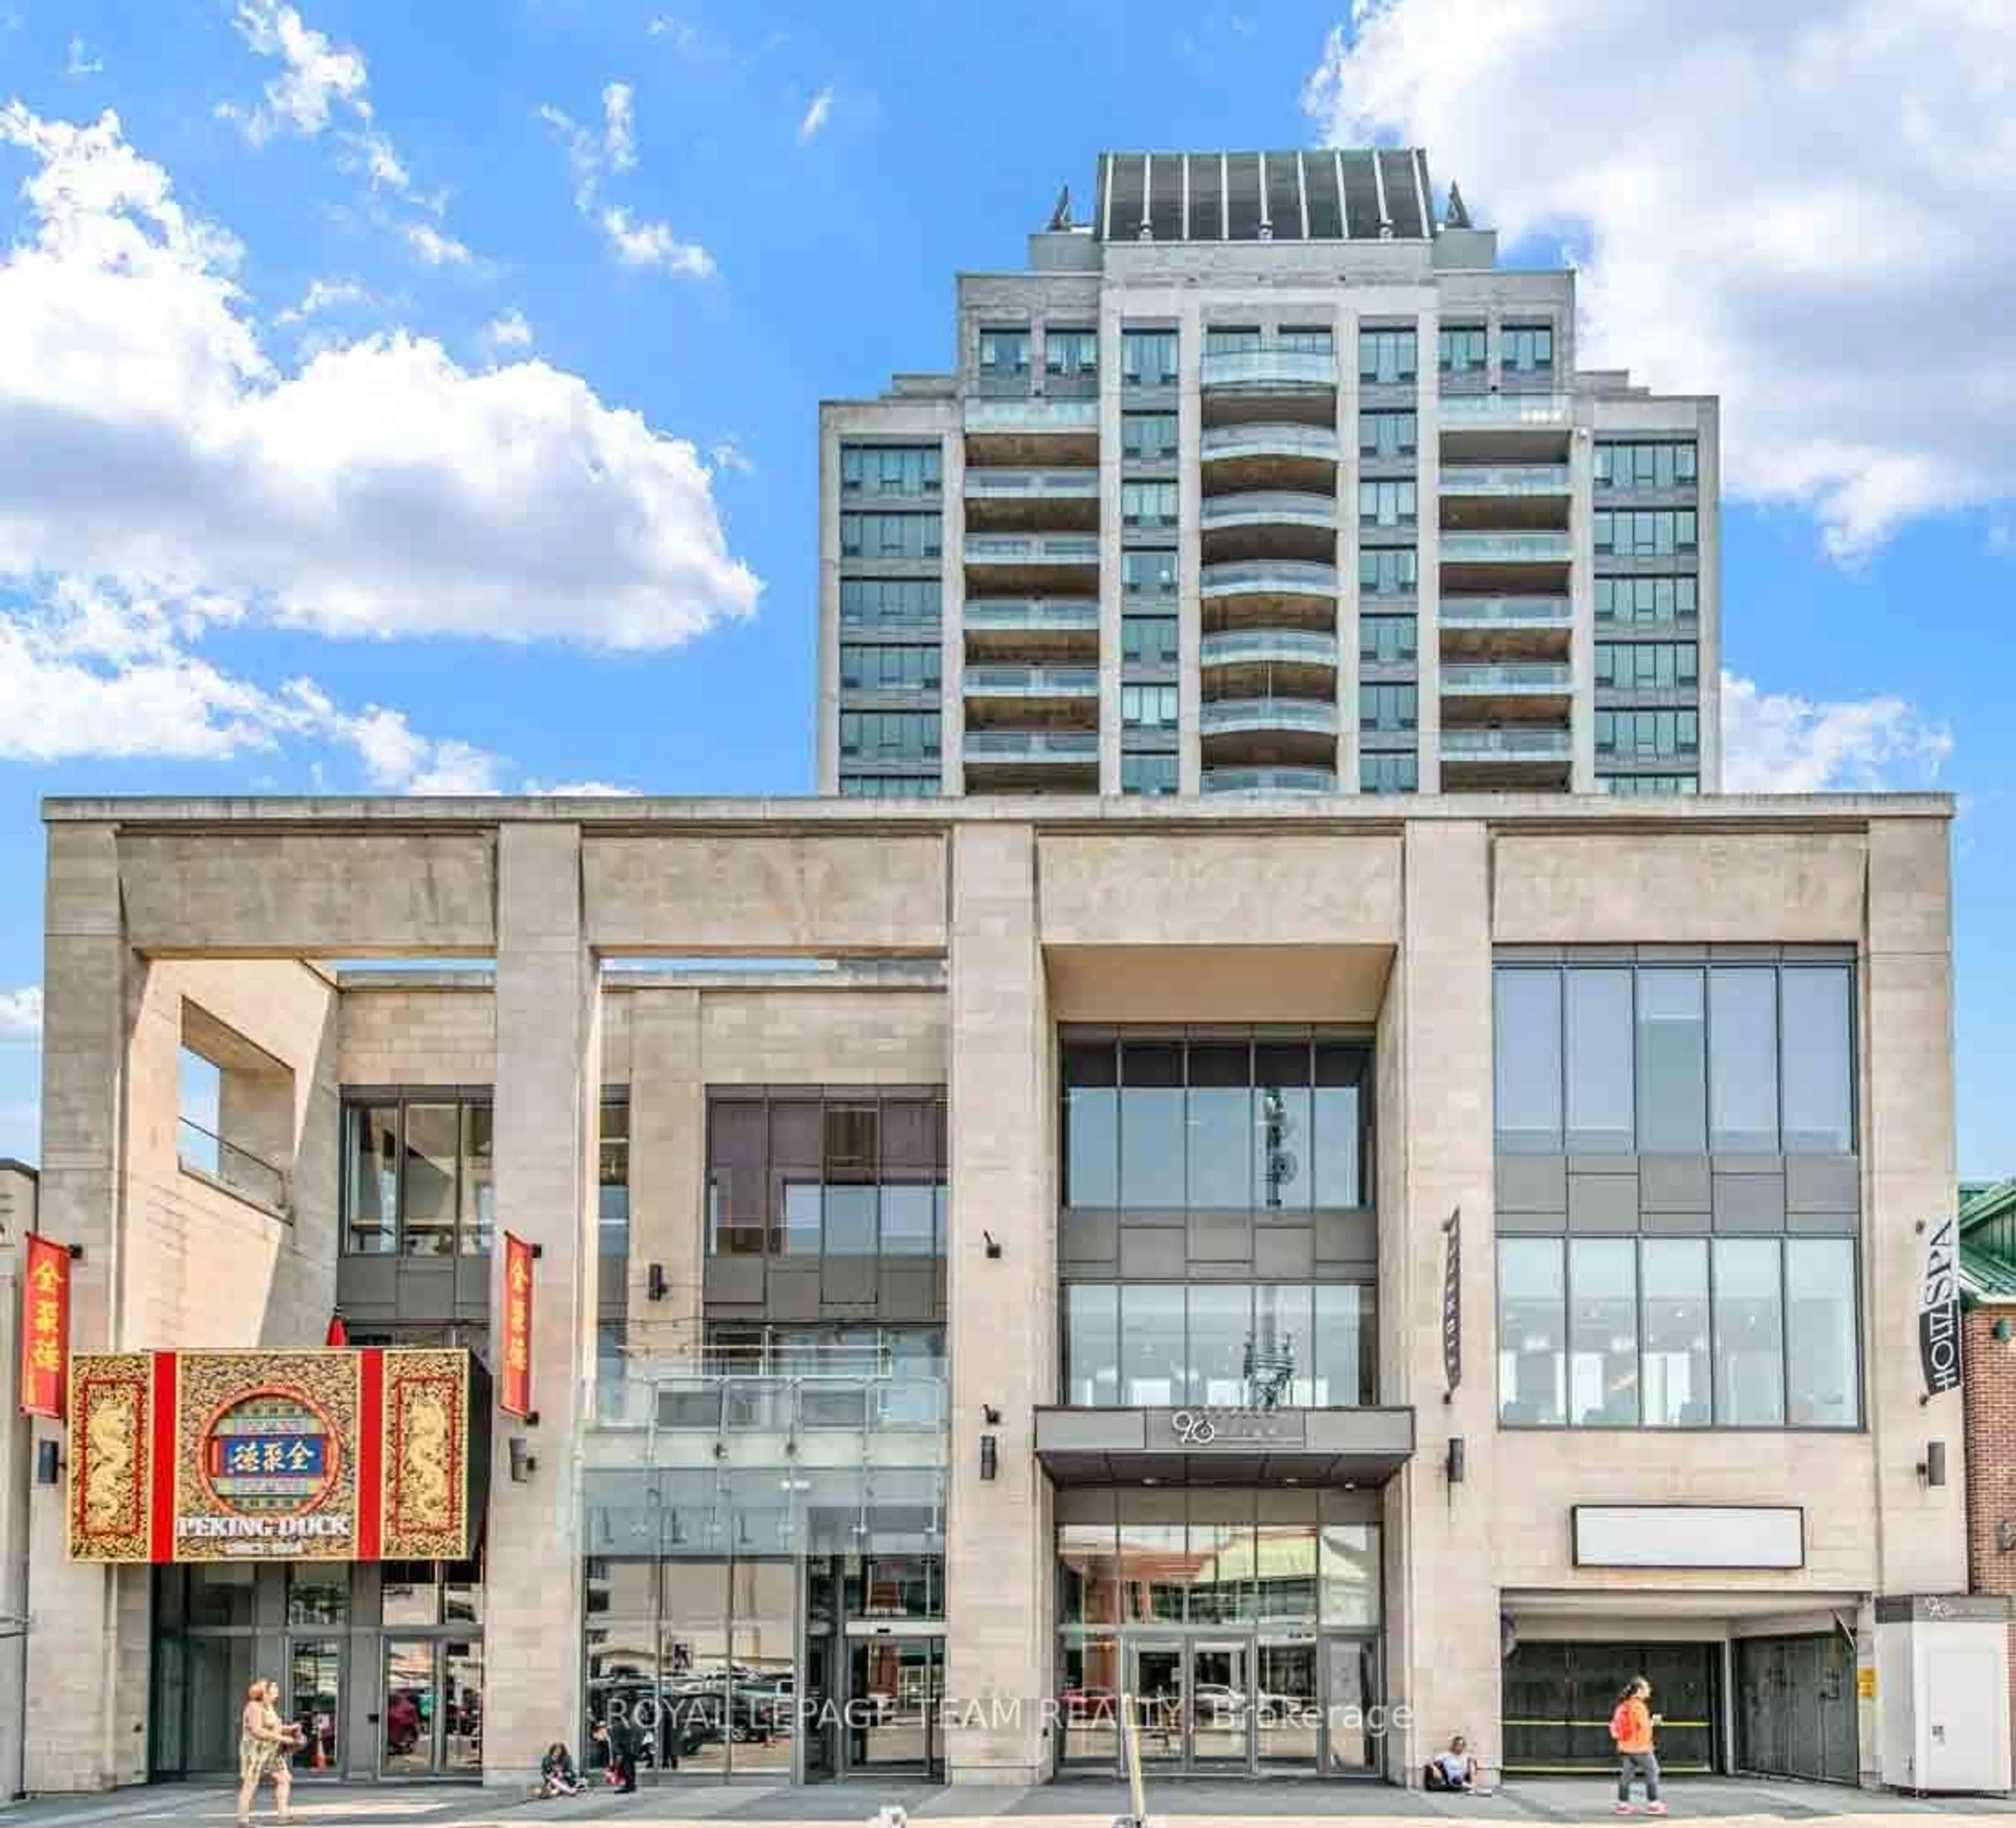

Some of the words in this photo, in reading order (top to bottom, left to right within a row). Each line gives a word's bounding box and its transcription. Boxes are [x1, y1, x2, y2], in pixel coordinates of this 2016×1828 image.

[1925, 1218, 1952, 1304] SPA
[177, 1517, 278, 1536] PEKING
[278, 1514, 350, 1535] DUCK
